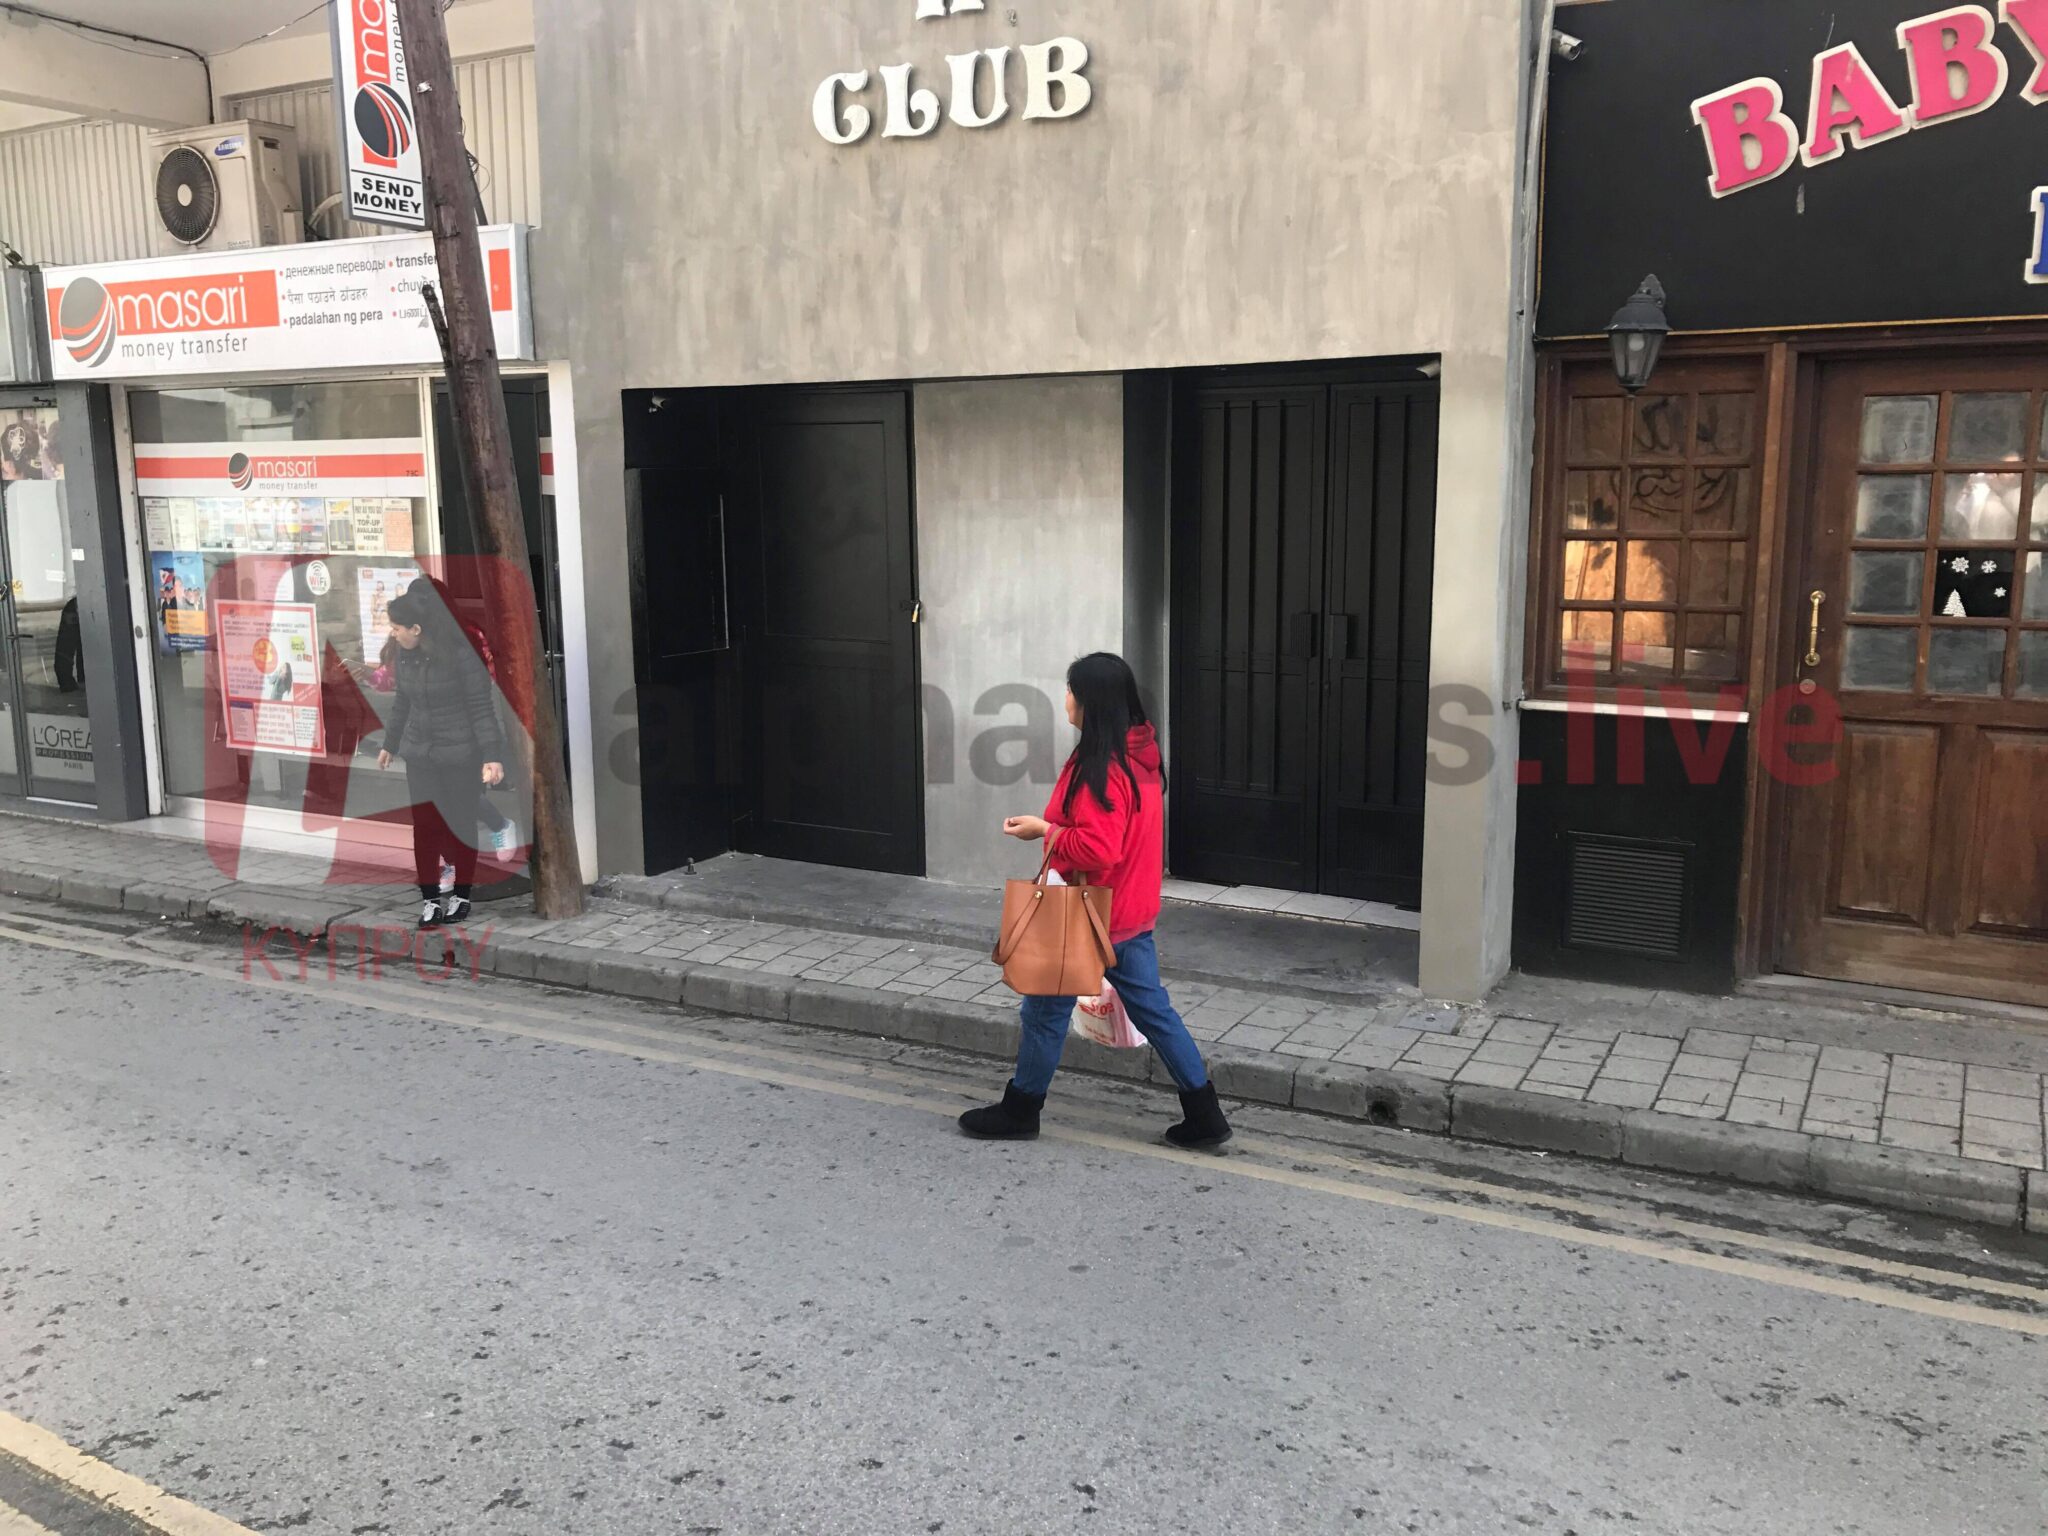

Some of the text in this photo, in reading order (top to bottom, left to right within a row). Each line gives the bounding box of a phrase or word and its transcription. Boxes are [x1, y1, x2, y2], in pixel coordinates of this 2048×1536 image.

[812, 35, 1092, 144] CLUB
[362, 177, 414, 198] SEND
[353, 191, 422, 214] MONEY
[285, 259, 386, 279] денежные переводы
[117, 275, 248, 331] masari
[289, 310, 383, 328] padalahan ng pera
[121, 333, 248, 361] money transfer
[257, 456, 318, 478] masari
[259, 481, 318, 491] money transfer
[64, 761, 84, 770] PARIS
